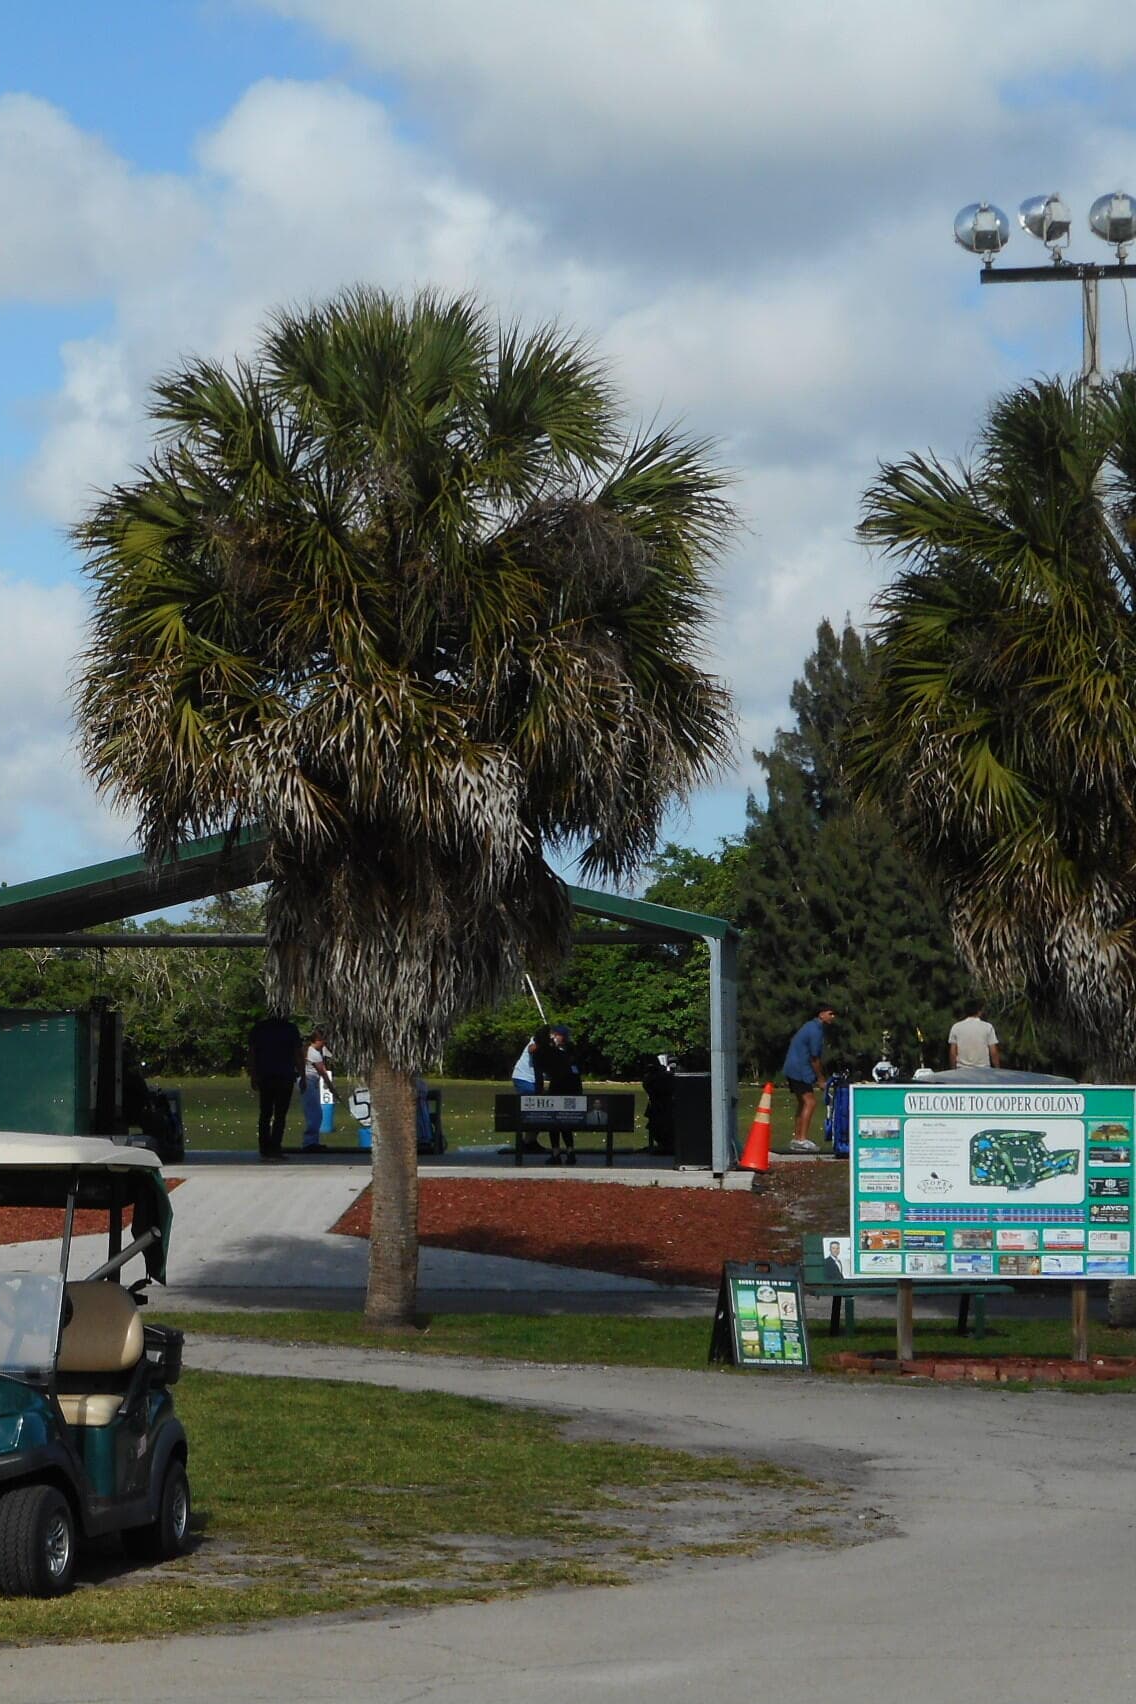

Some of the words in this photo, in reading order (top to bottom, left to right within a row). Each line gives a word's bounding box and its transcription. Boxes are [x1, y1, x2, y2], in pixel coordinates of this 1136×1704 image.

[908, 1095, 965, 1112] WELCOME
[968, 1095, 984, 1112] TO
[986, 1096, 1031, 1112] COOPER
[1034, 1096, 1082, 1112] COLONY
